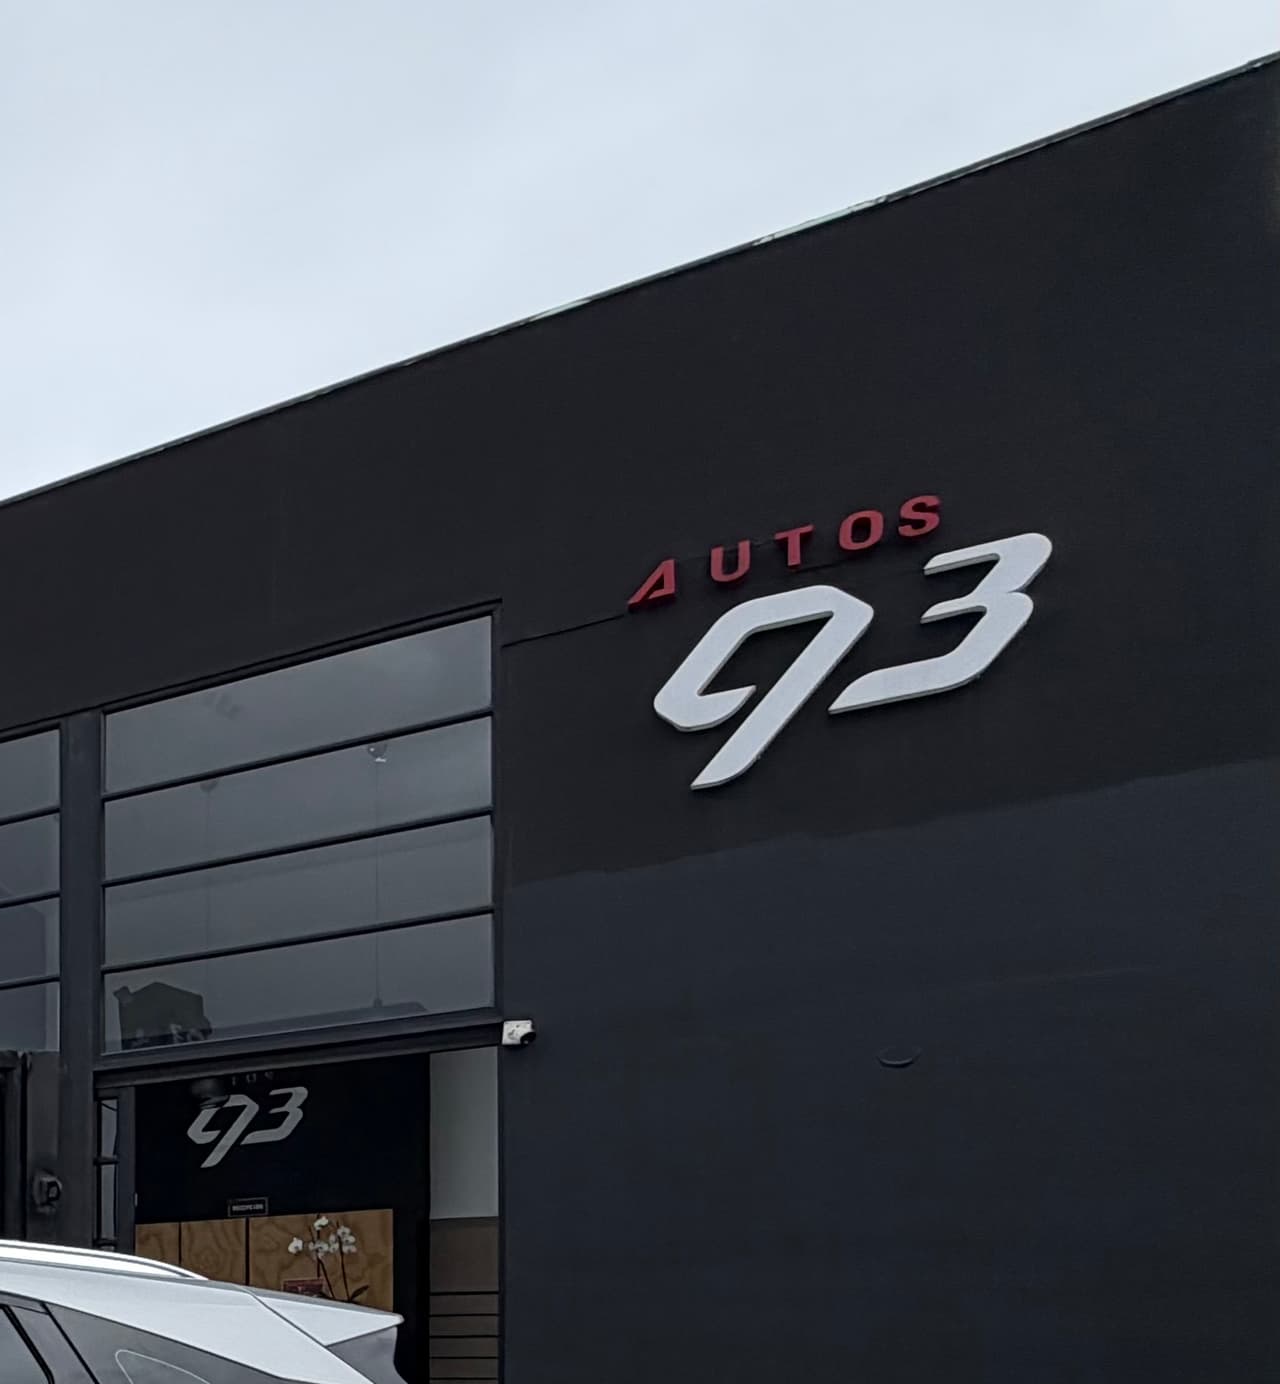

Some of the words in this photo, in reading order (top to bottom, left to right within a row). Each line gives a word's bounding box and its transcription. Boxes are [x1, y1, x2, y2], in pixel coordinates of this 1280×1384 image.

[627, 495, 940, 608] AUTOS
[653, 532, 1053, 790] 93
[186, 1086, 308, 1168] 93
